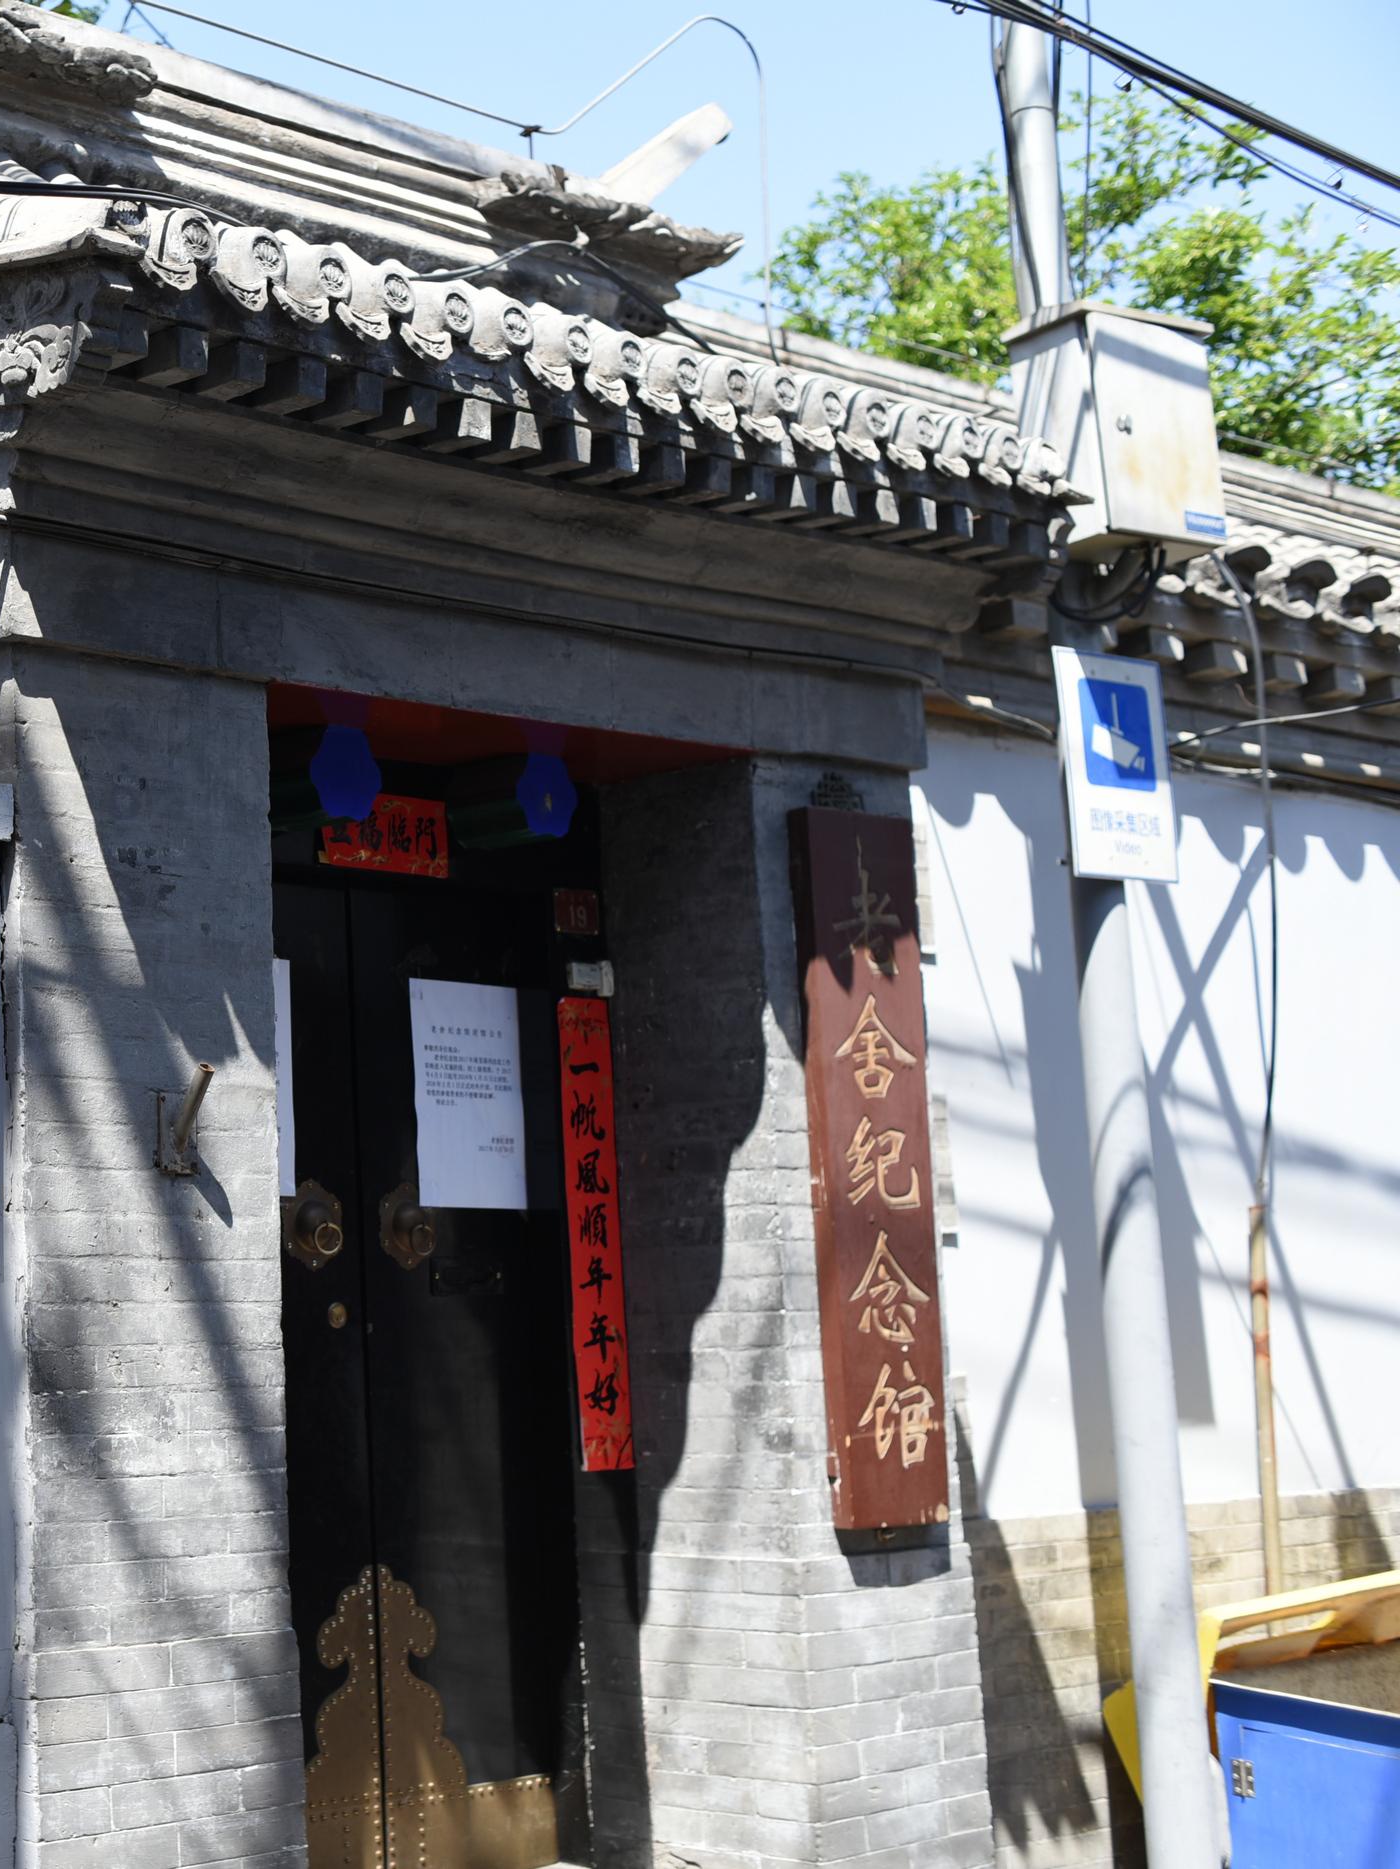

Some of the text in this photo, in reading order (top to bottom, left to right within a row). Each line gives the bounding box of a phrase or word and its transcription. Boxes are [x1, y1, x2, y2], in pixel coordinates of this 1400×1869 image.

[569, 904, 587, 927] 19
[832, 868, 934, 1469] 老舍纪念馆
